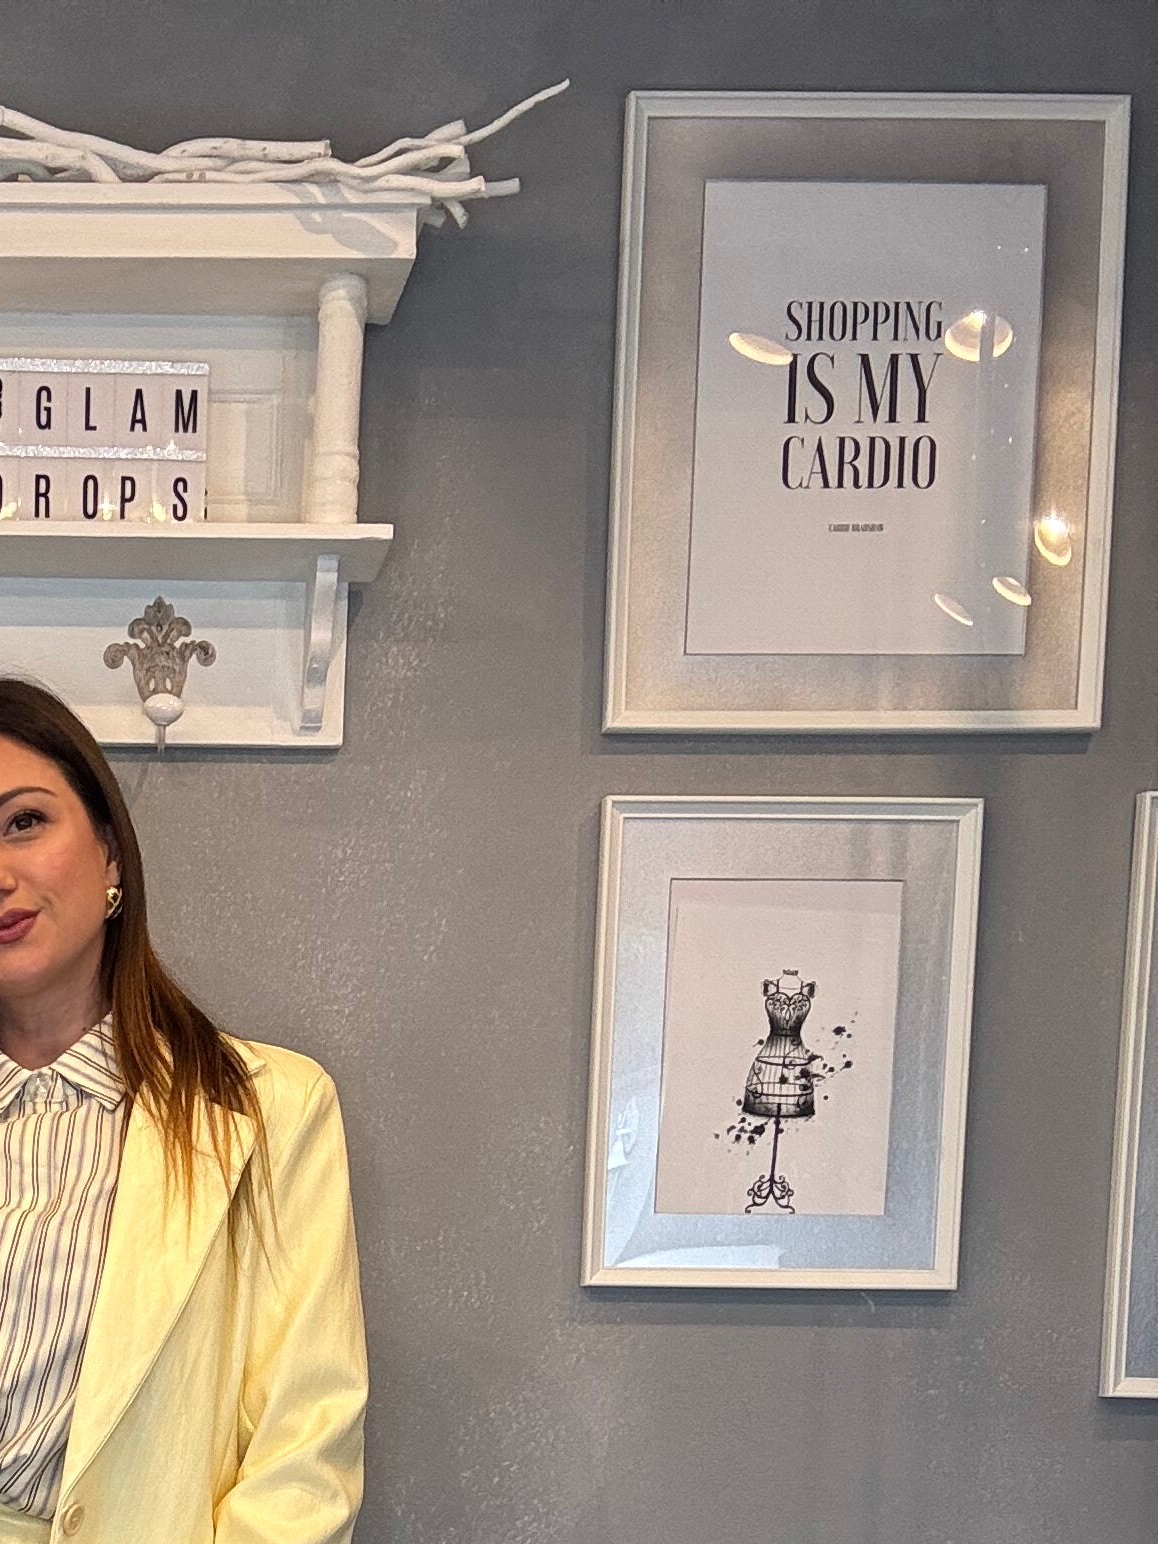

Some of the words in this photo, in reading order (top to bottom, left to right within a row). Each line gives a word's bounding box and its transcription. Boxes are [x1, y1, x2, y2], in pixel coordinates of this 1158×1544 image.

[785, 300, 943, 342] SHOPPING
[35, 386, 198, 433] GLAM
[783, 352, 835, 425] IS
[853, 353, 943, 424] MY
[781, 435, 937, 490] CARDIO
